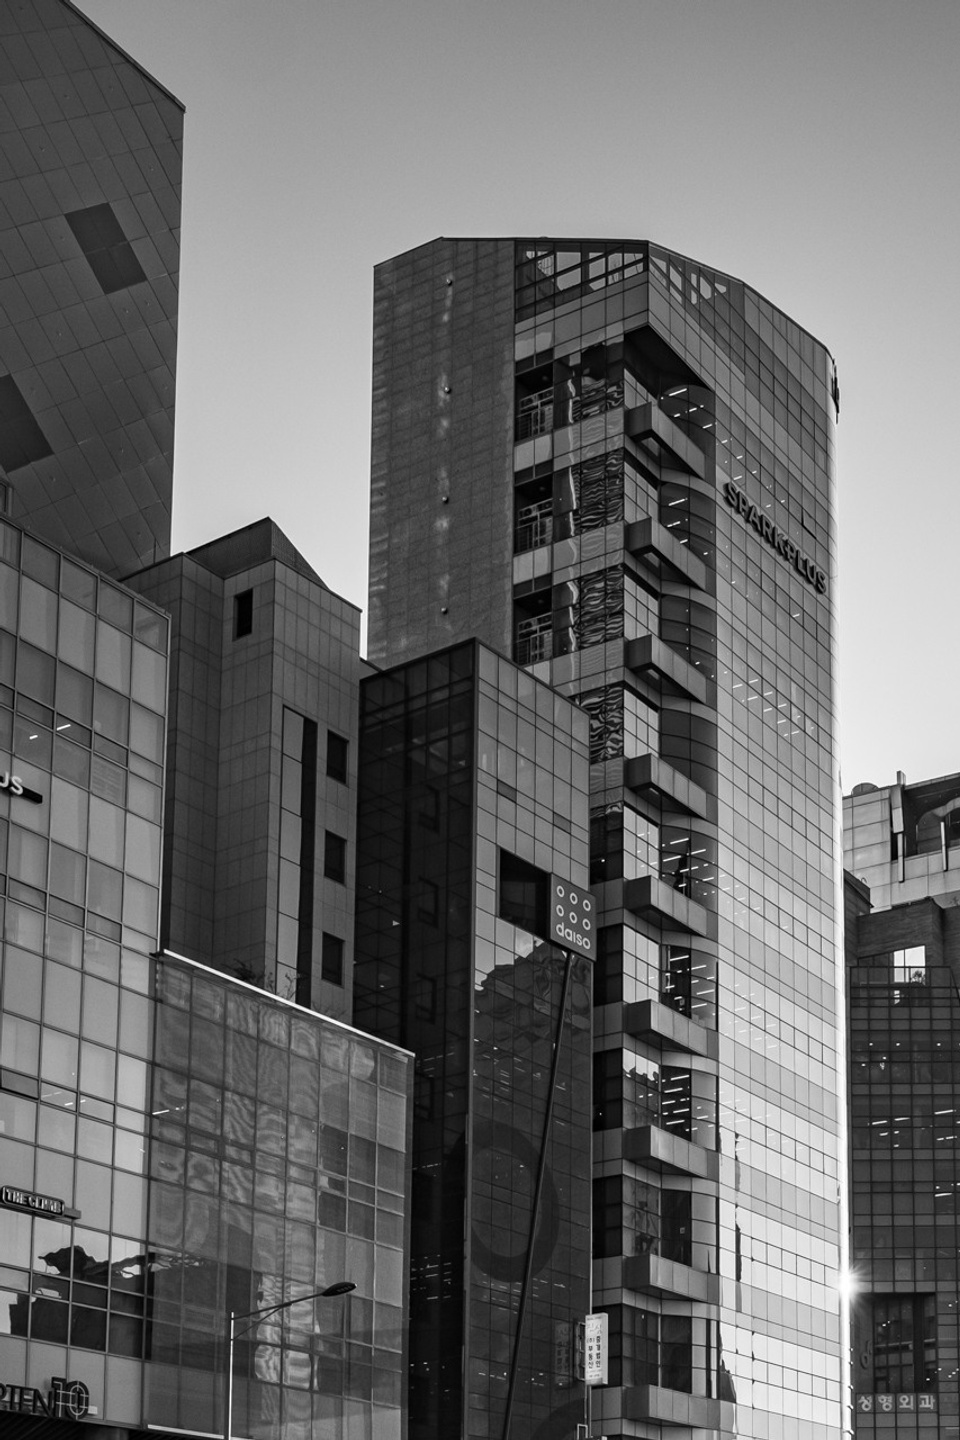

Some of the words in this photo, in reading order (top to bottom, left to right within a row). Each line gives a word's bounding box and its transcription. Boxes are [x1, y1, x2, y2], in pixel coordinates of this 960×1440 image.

[723, 482, 826, 594] SPARKPLUS
[556, 921, 591, 950] daiso
[858, 1394, 936, 1412] 성형외과
